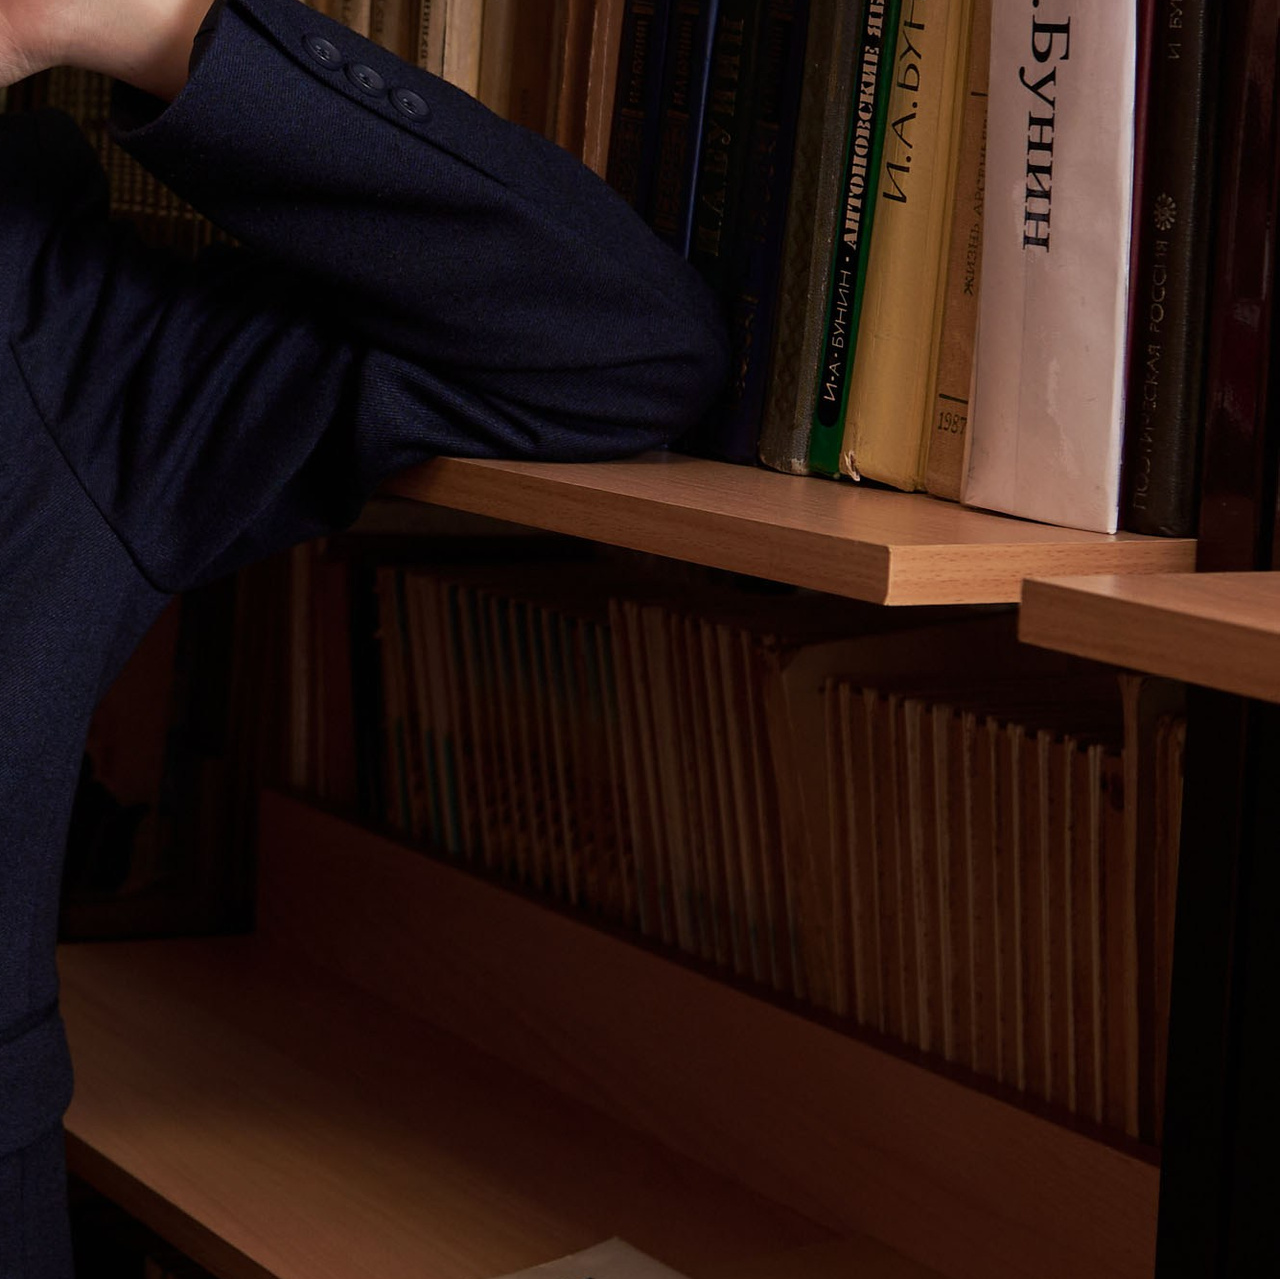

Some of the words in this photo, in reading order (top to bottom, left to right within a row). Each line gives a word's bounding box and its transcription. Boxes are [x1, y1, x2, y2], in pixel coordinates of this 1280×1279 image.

[843, 45, 880, 252] АНТОНОВСКИЕ
[964, 227, 982, 297] ЖИЗНЬ
[1150, 237, 1168, 333] РОССИЯ
